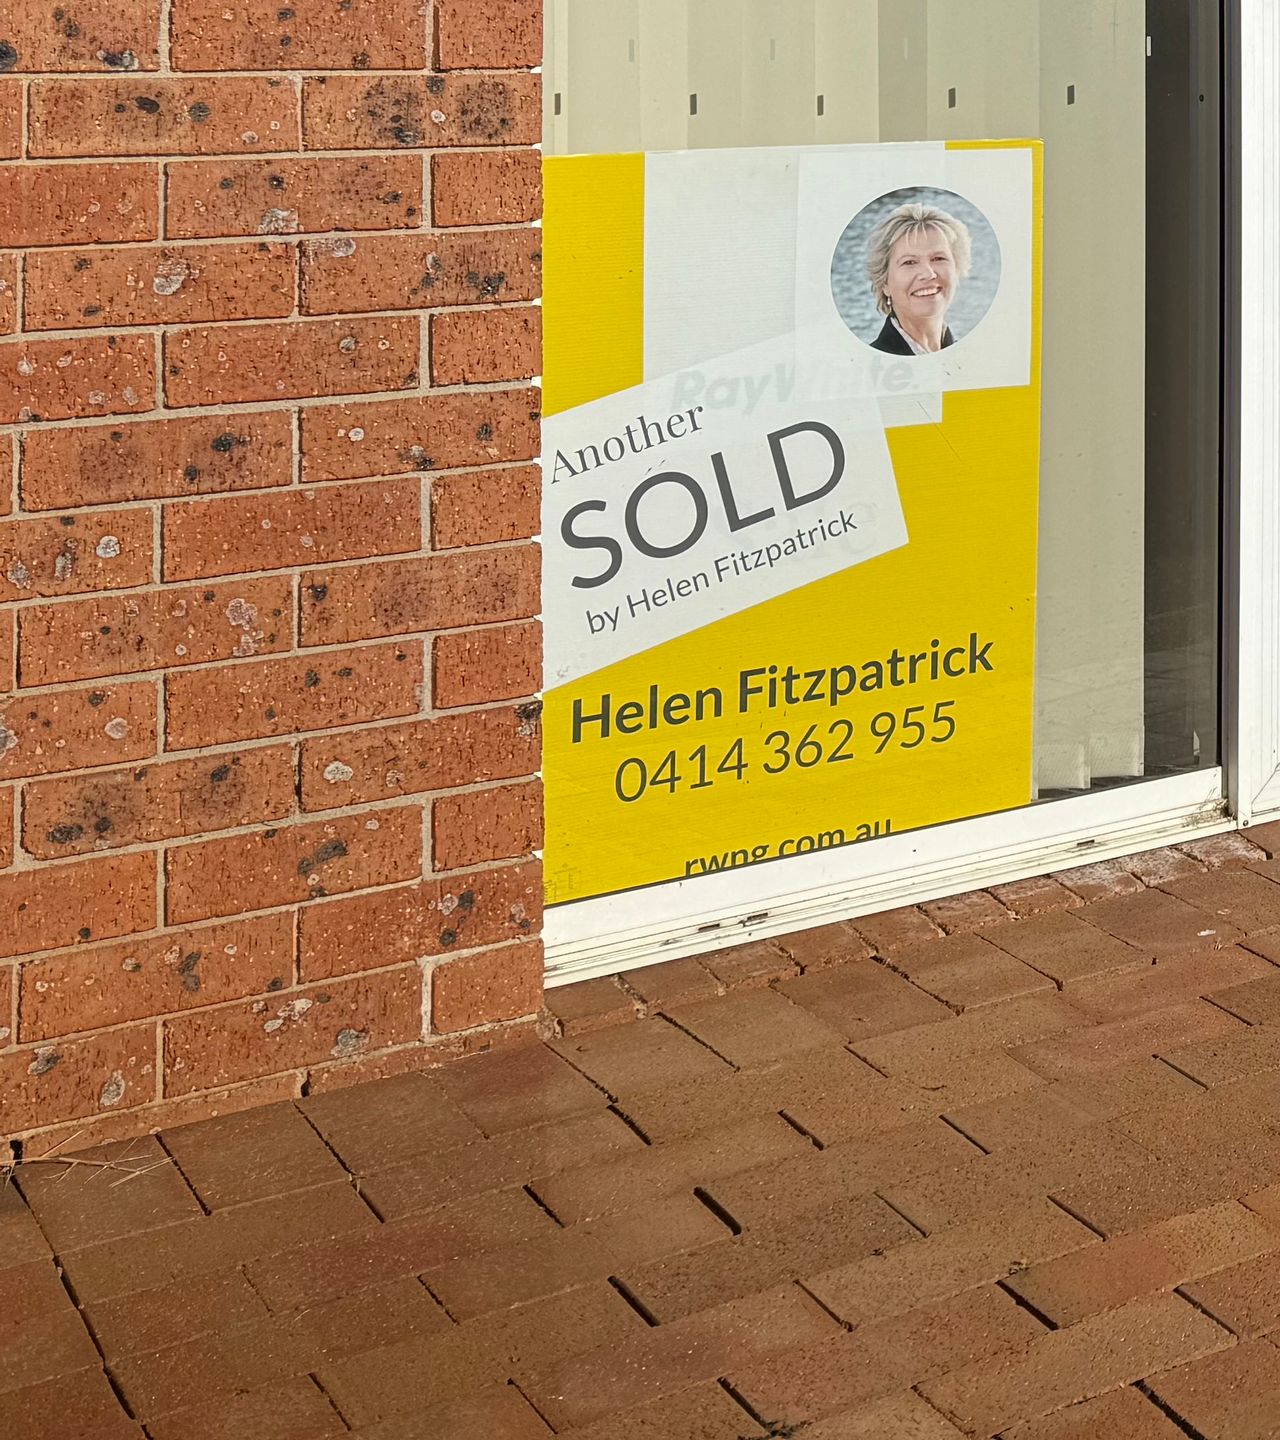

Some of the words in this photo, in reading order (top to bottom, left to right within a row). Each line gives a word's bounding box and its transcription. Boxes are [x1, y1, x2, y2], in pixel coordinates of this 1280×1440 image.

[550, 405, 705, 485] Another
[560, 421, 846, 590] SOLD
[585, 604, 621, 635] by
[626, 572, 711, 618] Helen
[713, 510, 859, 583] Fitzpatrick
[572, 684, 723, 744] Helen
[738, 632, 995, 713] Fitzpatrick
[614, 737, 750, 803] 0414
[762, 719, 855, 774] 362
[869, 700, 957, 755] 955
[685, 819, 892, 877] rwngcomau
